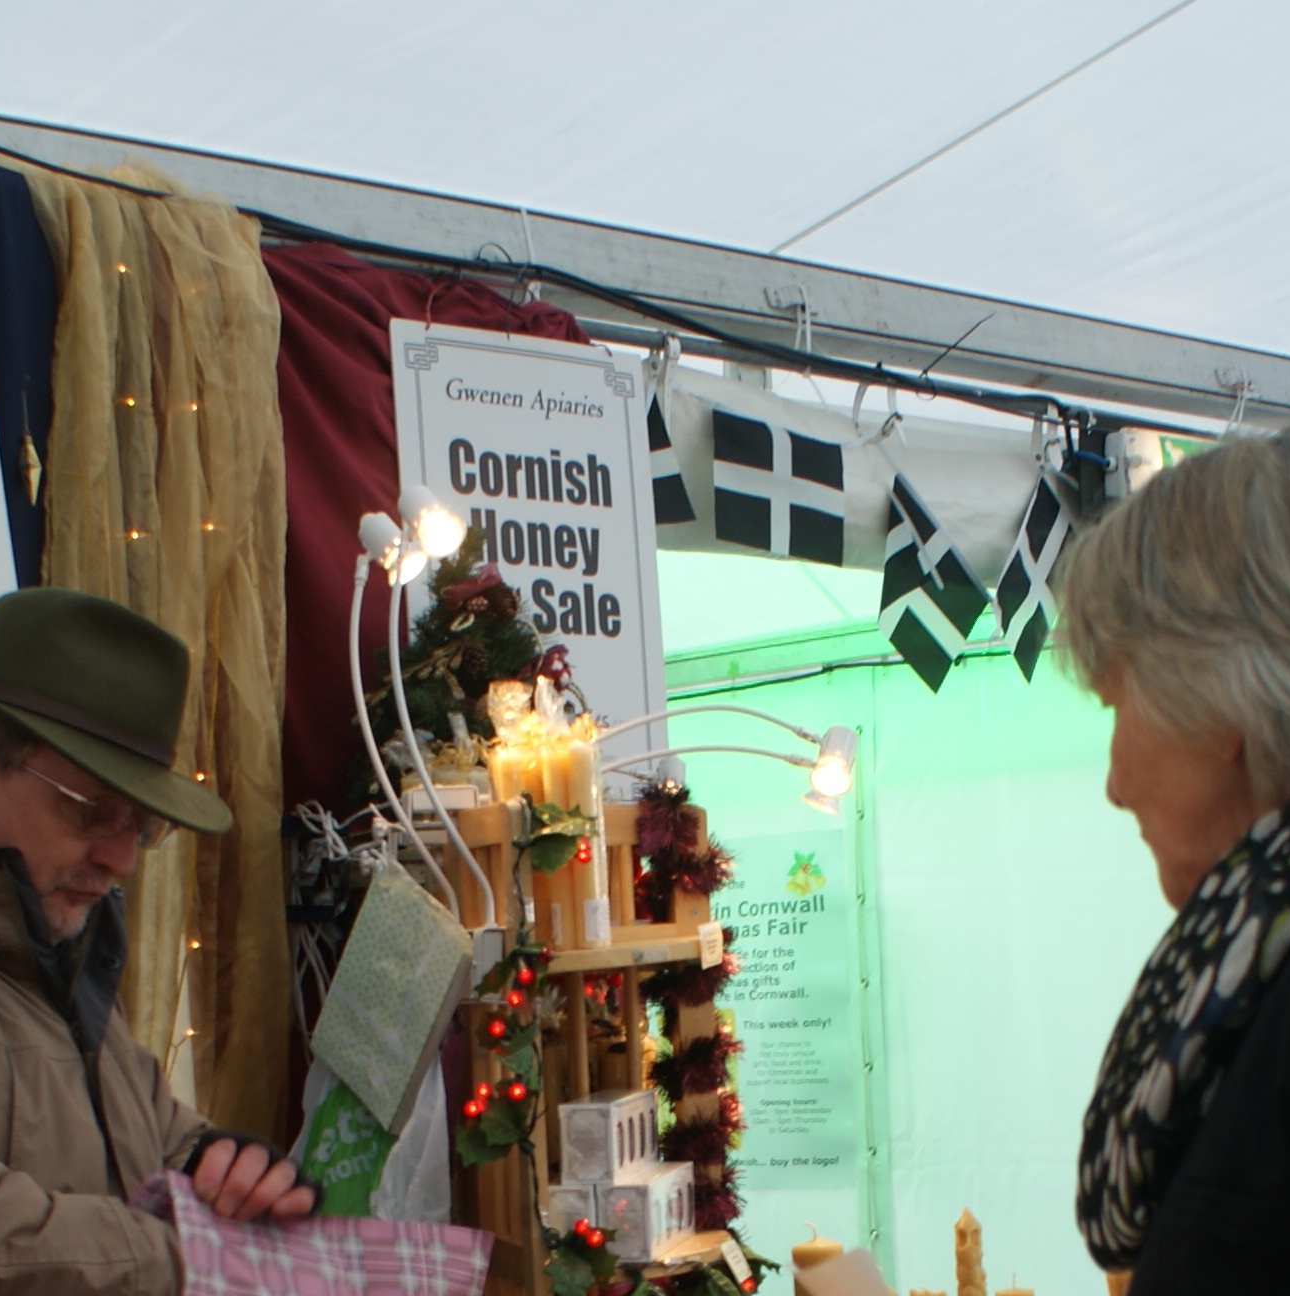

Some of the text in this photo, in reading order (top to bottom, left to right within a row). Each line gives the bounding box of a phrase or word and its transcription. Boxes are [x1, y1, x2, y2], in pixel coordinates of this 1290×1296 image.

[445, 378, 605, 420] Gwenen Apiaries
[448, 437, 613, 508] Cornish
[469, 507, 600, 577] Honey
[531, 578, 621, 638] Sale
[738, 894, 826, 917] Cornwall
[767, 917, 808, 936] Fair
[752, 948, 769, 958] for
[772, 947, 795, 958] the
[782, 960, 796, 971] of
[752, 975, 781, 988] gifts
[743, 1017, 832, 1030] This week only!
[791, 1156, 810, 1166] the
